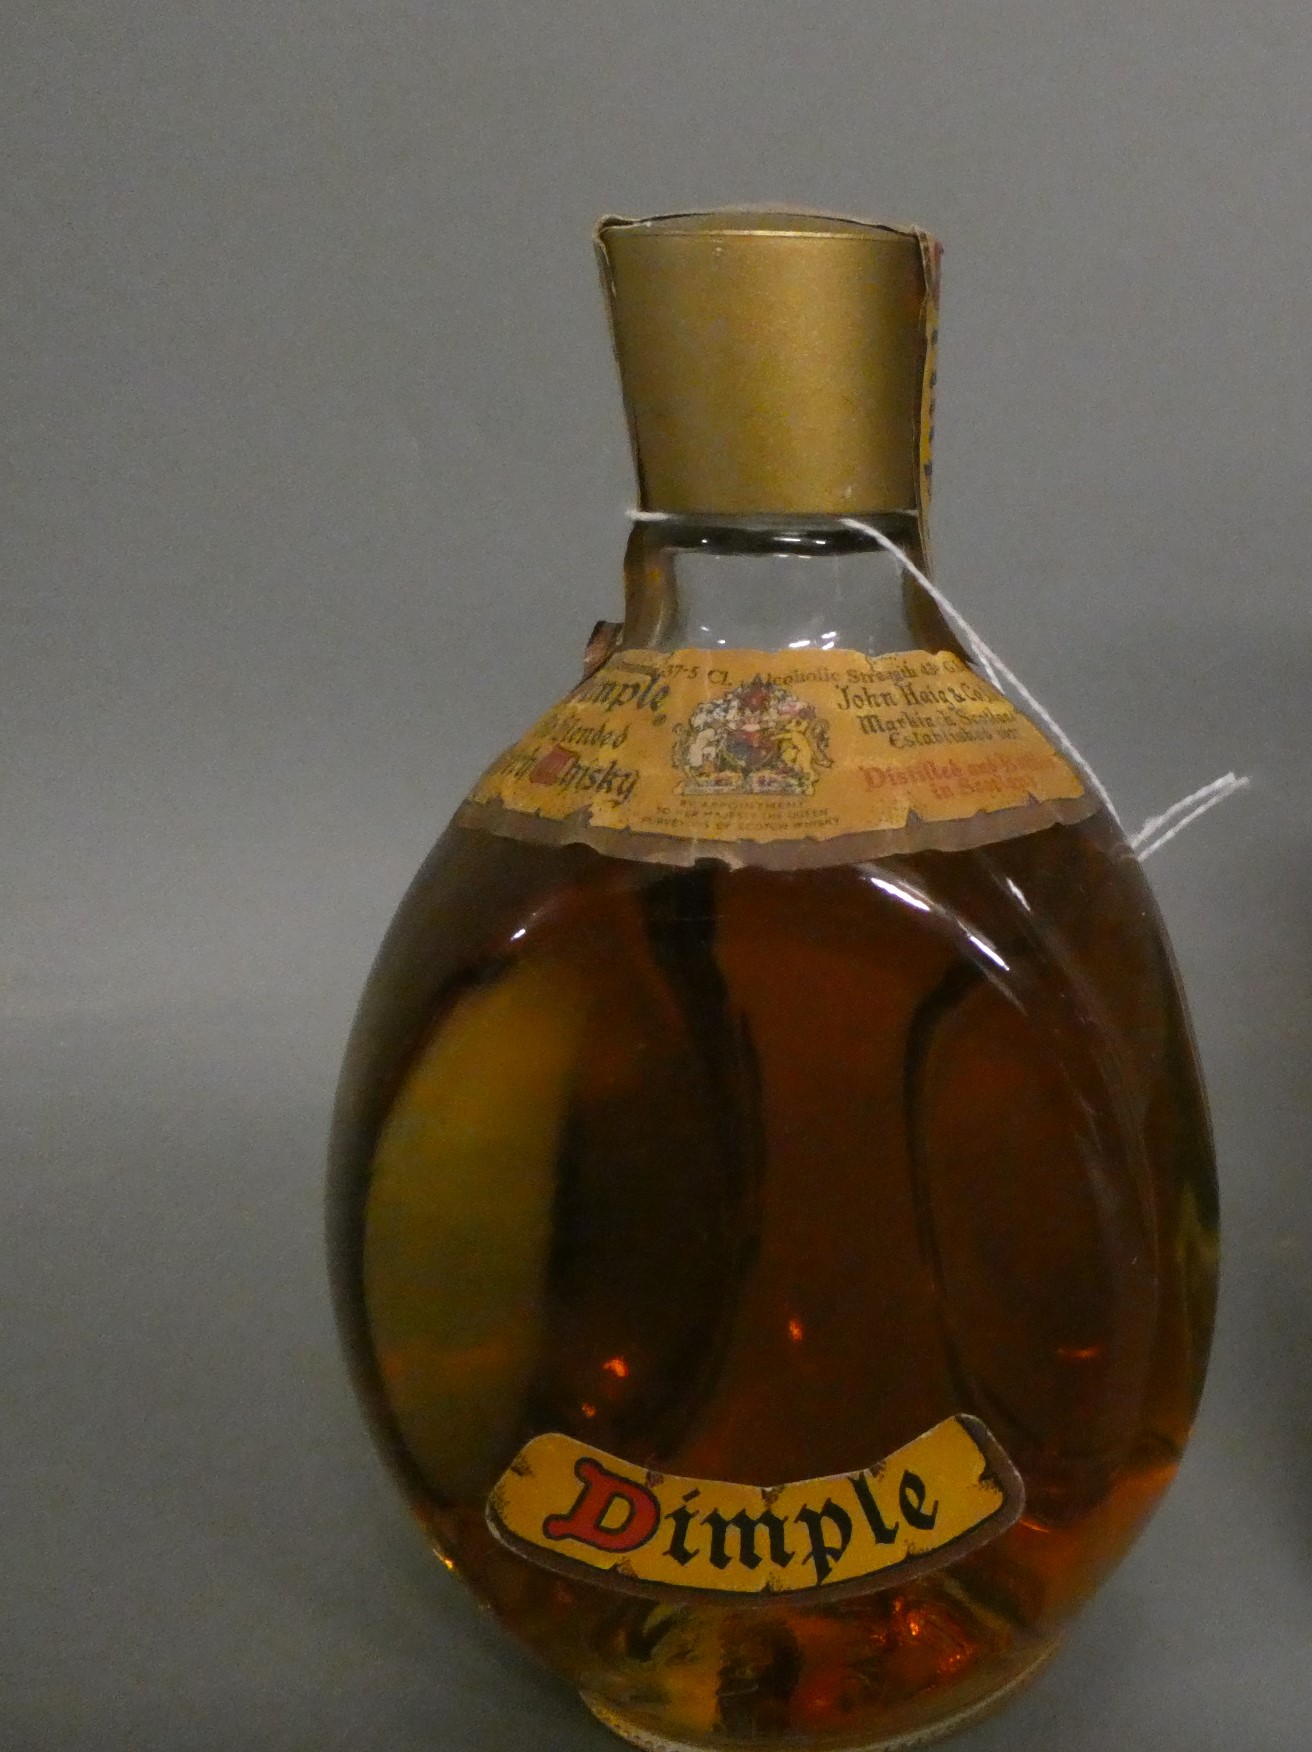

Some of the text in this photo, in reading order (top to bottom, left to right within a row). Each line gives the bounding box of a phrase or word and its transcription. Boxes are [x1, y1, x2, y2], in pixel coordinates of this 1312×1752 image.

[836, 684, 897, 711] John
[894, 681, 955, 712] Haig
[542, 1456, 939, 1586] Dimple
